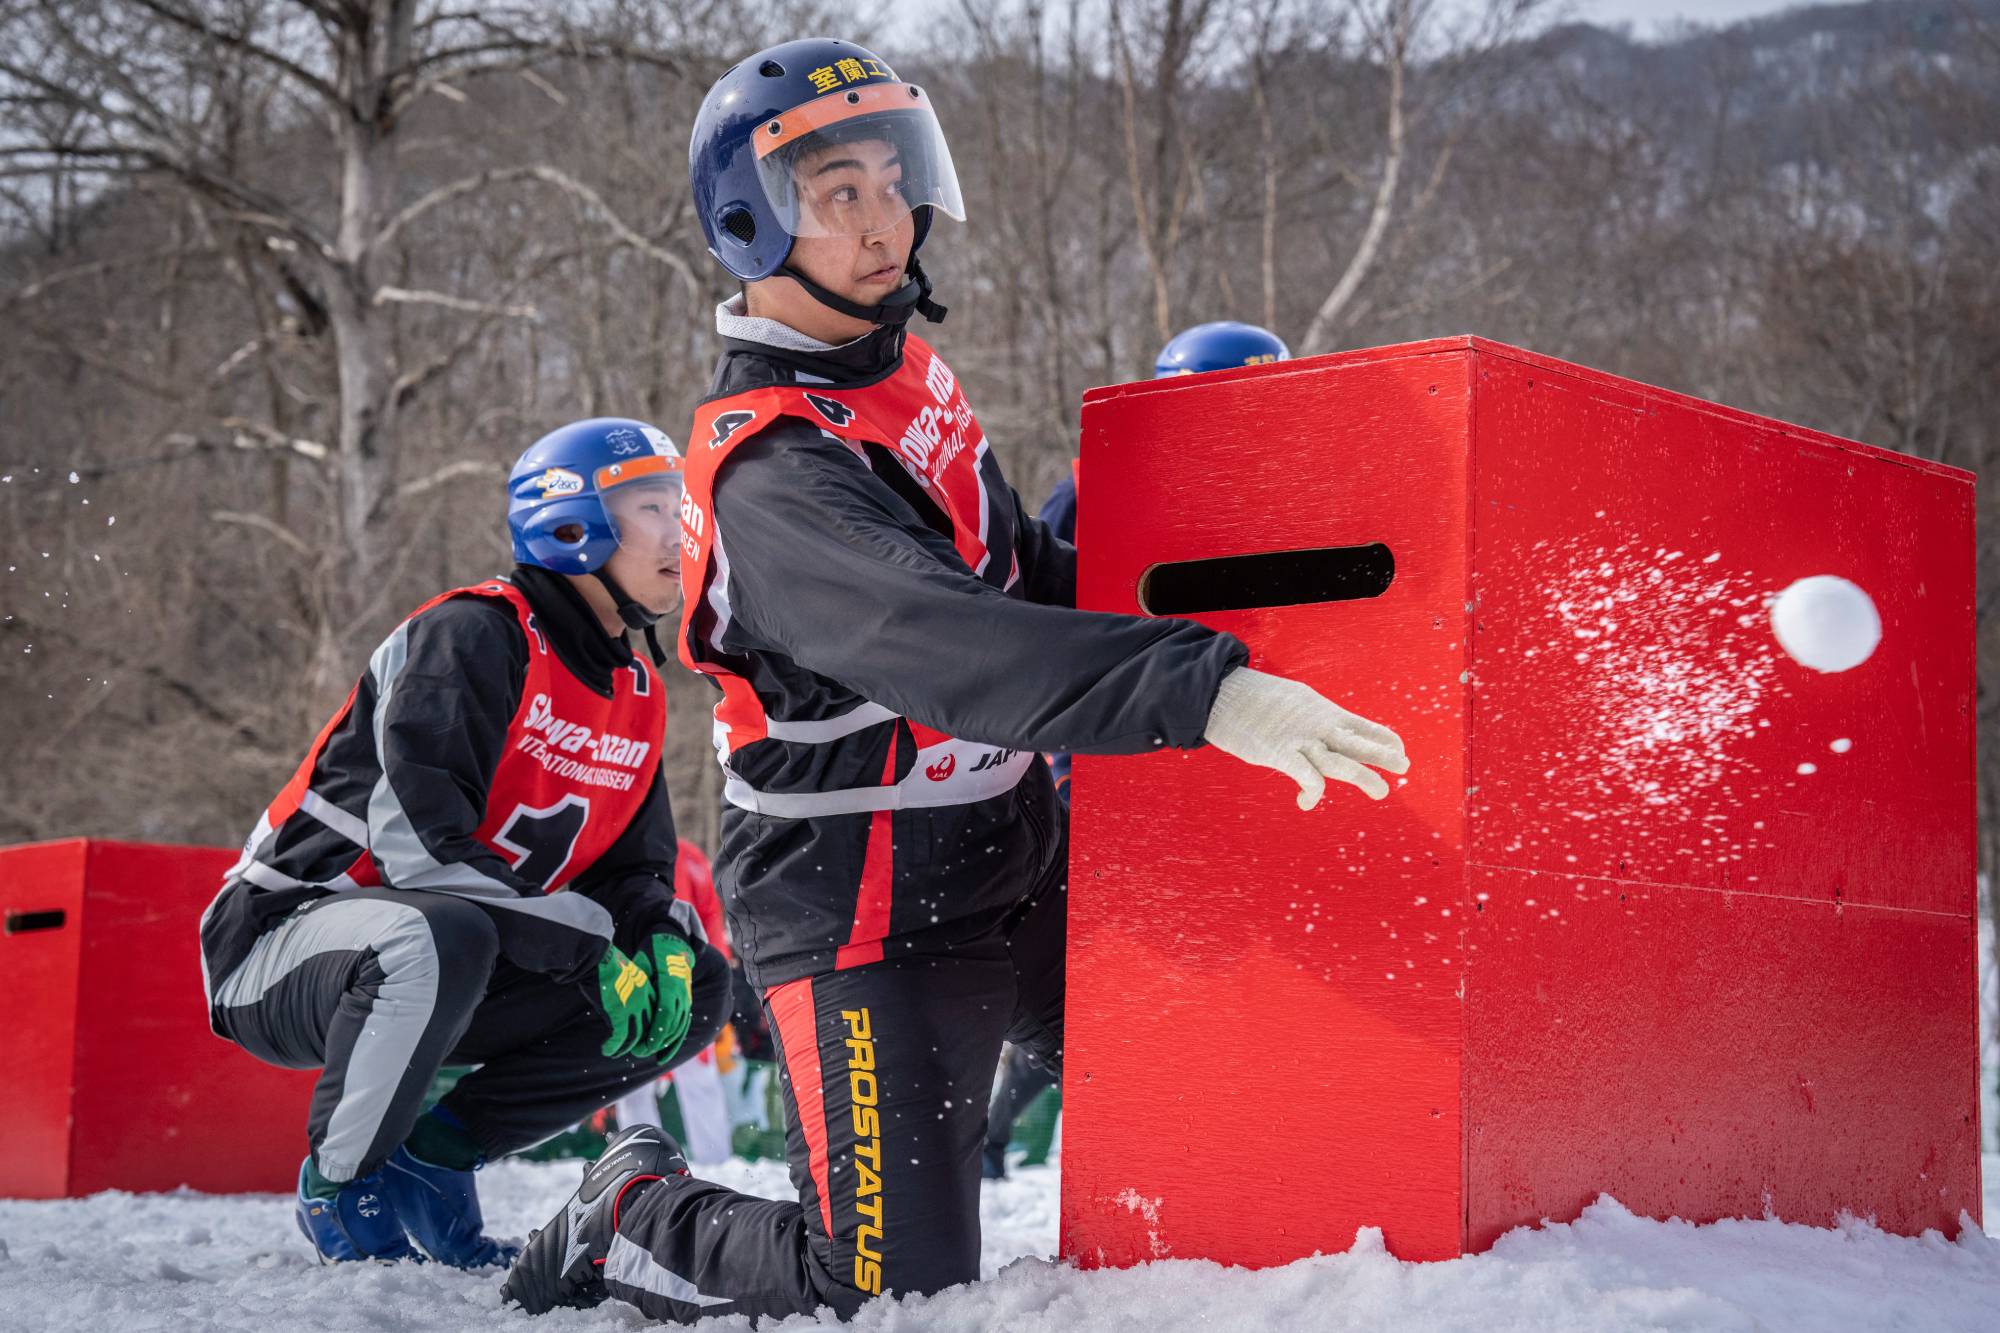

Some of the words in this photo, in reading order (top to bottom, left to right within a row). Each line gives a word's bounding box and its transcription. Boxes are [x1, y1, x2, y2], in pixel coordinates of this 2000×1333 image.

[807, 57, 897, 95] 室蘭工
[803, 391, 856, 427] 4
[709, 410, 756, 449] 4
[969, 748, 1018, 772] JAP
[841, 1007, 884, 1297] PROSTATUS
